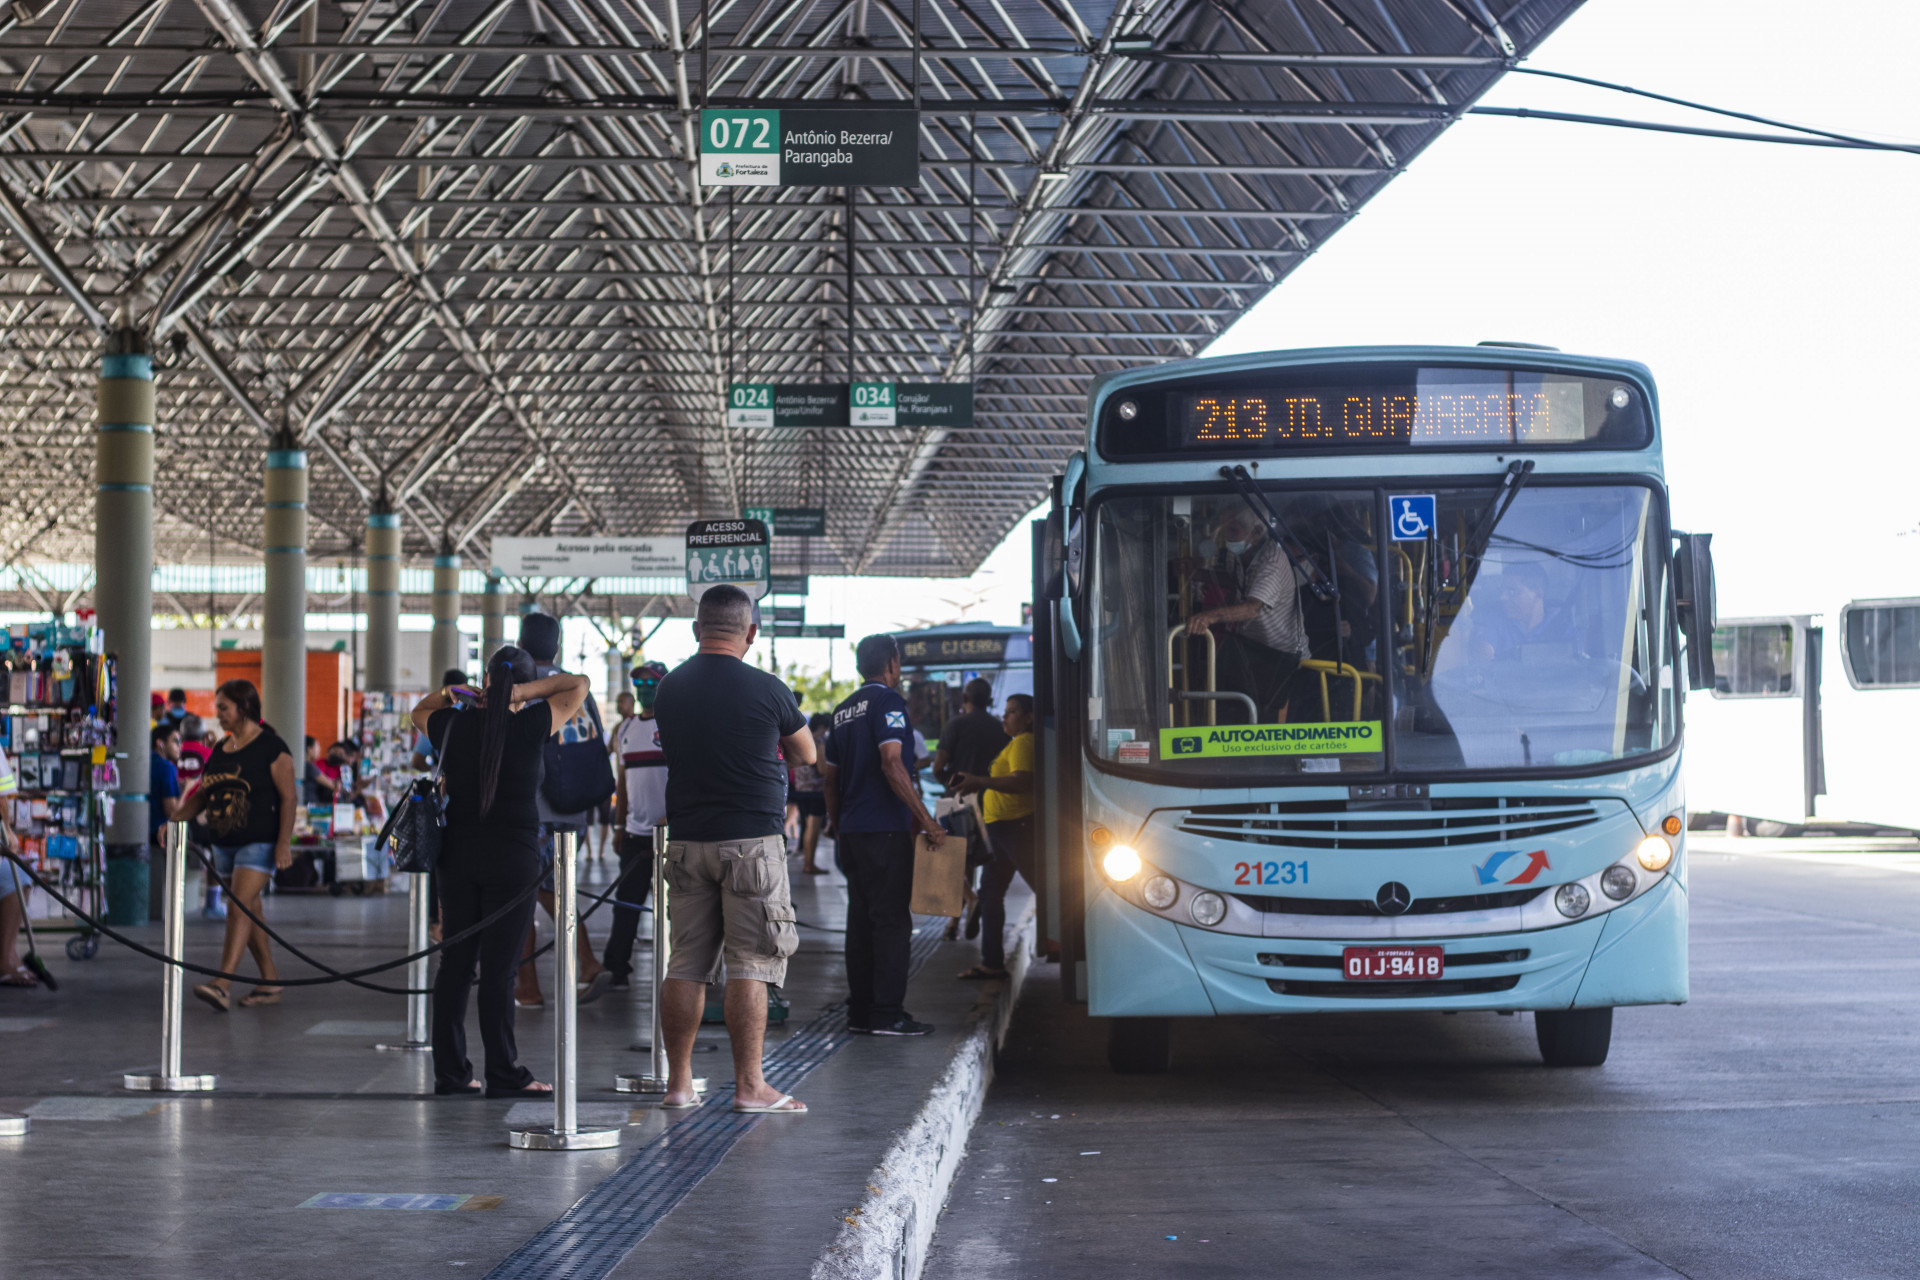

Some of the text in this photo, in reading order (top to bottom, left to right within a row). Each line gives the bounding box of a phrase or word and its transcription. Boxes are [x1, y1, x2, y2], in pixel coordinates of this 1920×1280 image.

[710, 117, 770, 149] 072
[784, 130, 893, 146] Antônio Bezerra/
[785, 149, 853, 167] Parangaba
[733, 388, 769, 407] 024
[775, 395, 805, 405] Antônio
[855, 386, 891, 405] 034
[1196, 393, 1550, 439] 213 JD. GUANABARA
[747, 510, 771, 522] 212
[705, 521, 745, 532] ACESSO
[689, 532, 762, 545] PREFERENCIAL
[556, 542, 590, 553] Acesso
[618, 542, 653, 553] escada
[1208, 725, 1373, 743] AUTOATENDIMENTO
[1222, 740, 1348, 753] Uso exclusivo de cartões
[1234, 860, 1308, 885] 21231
